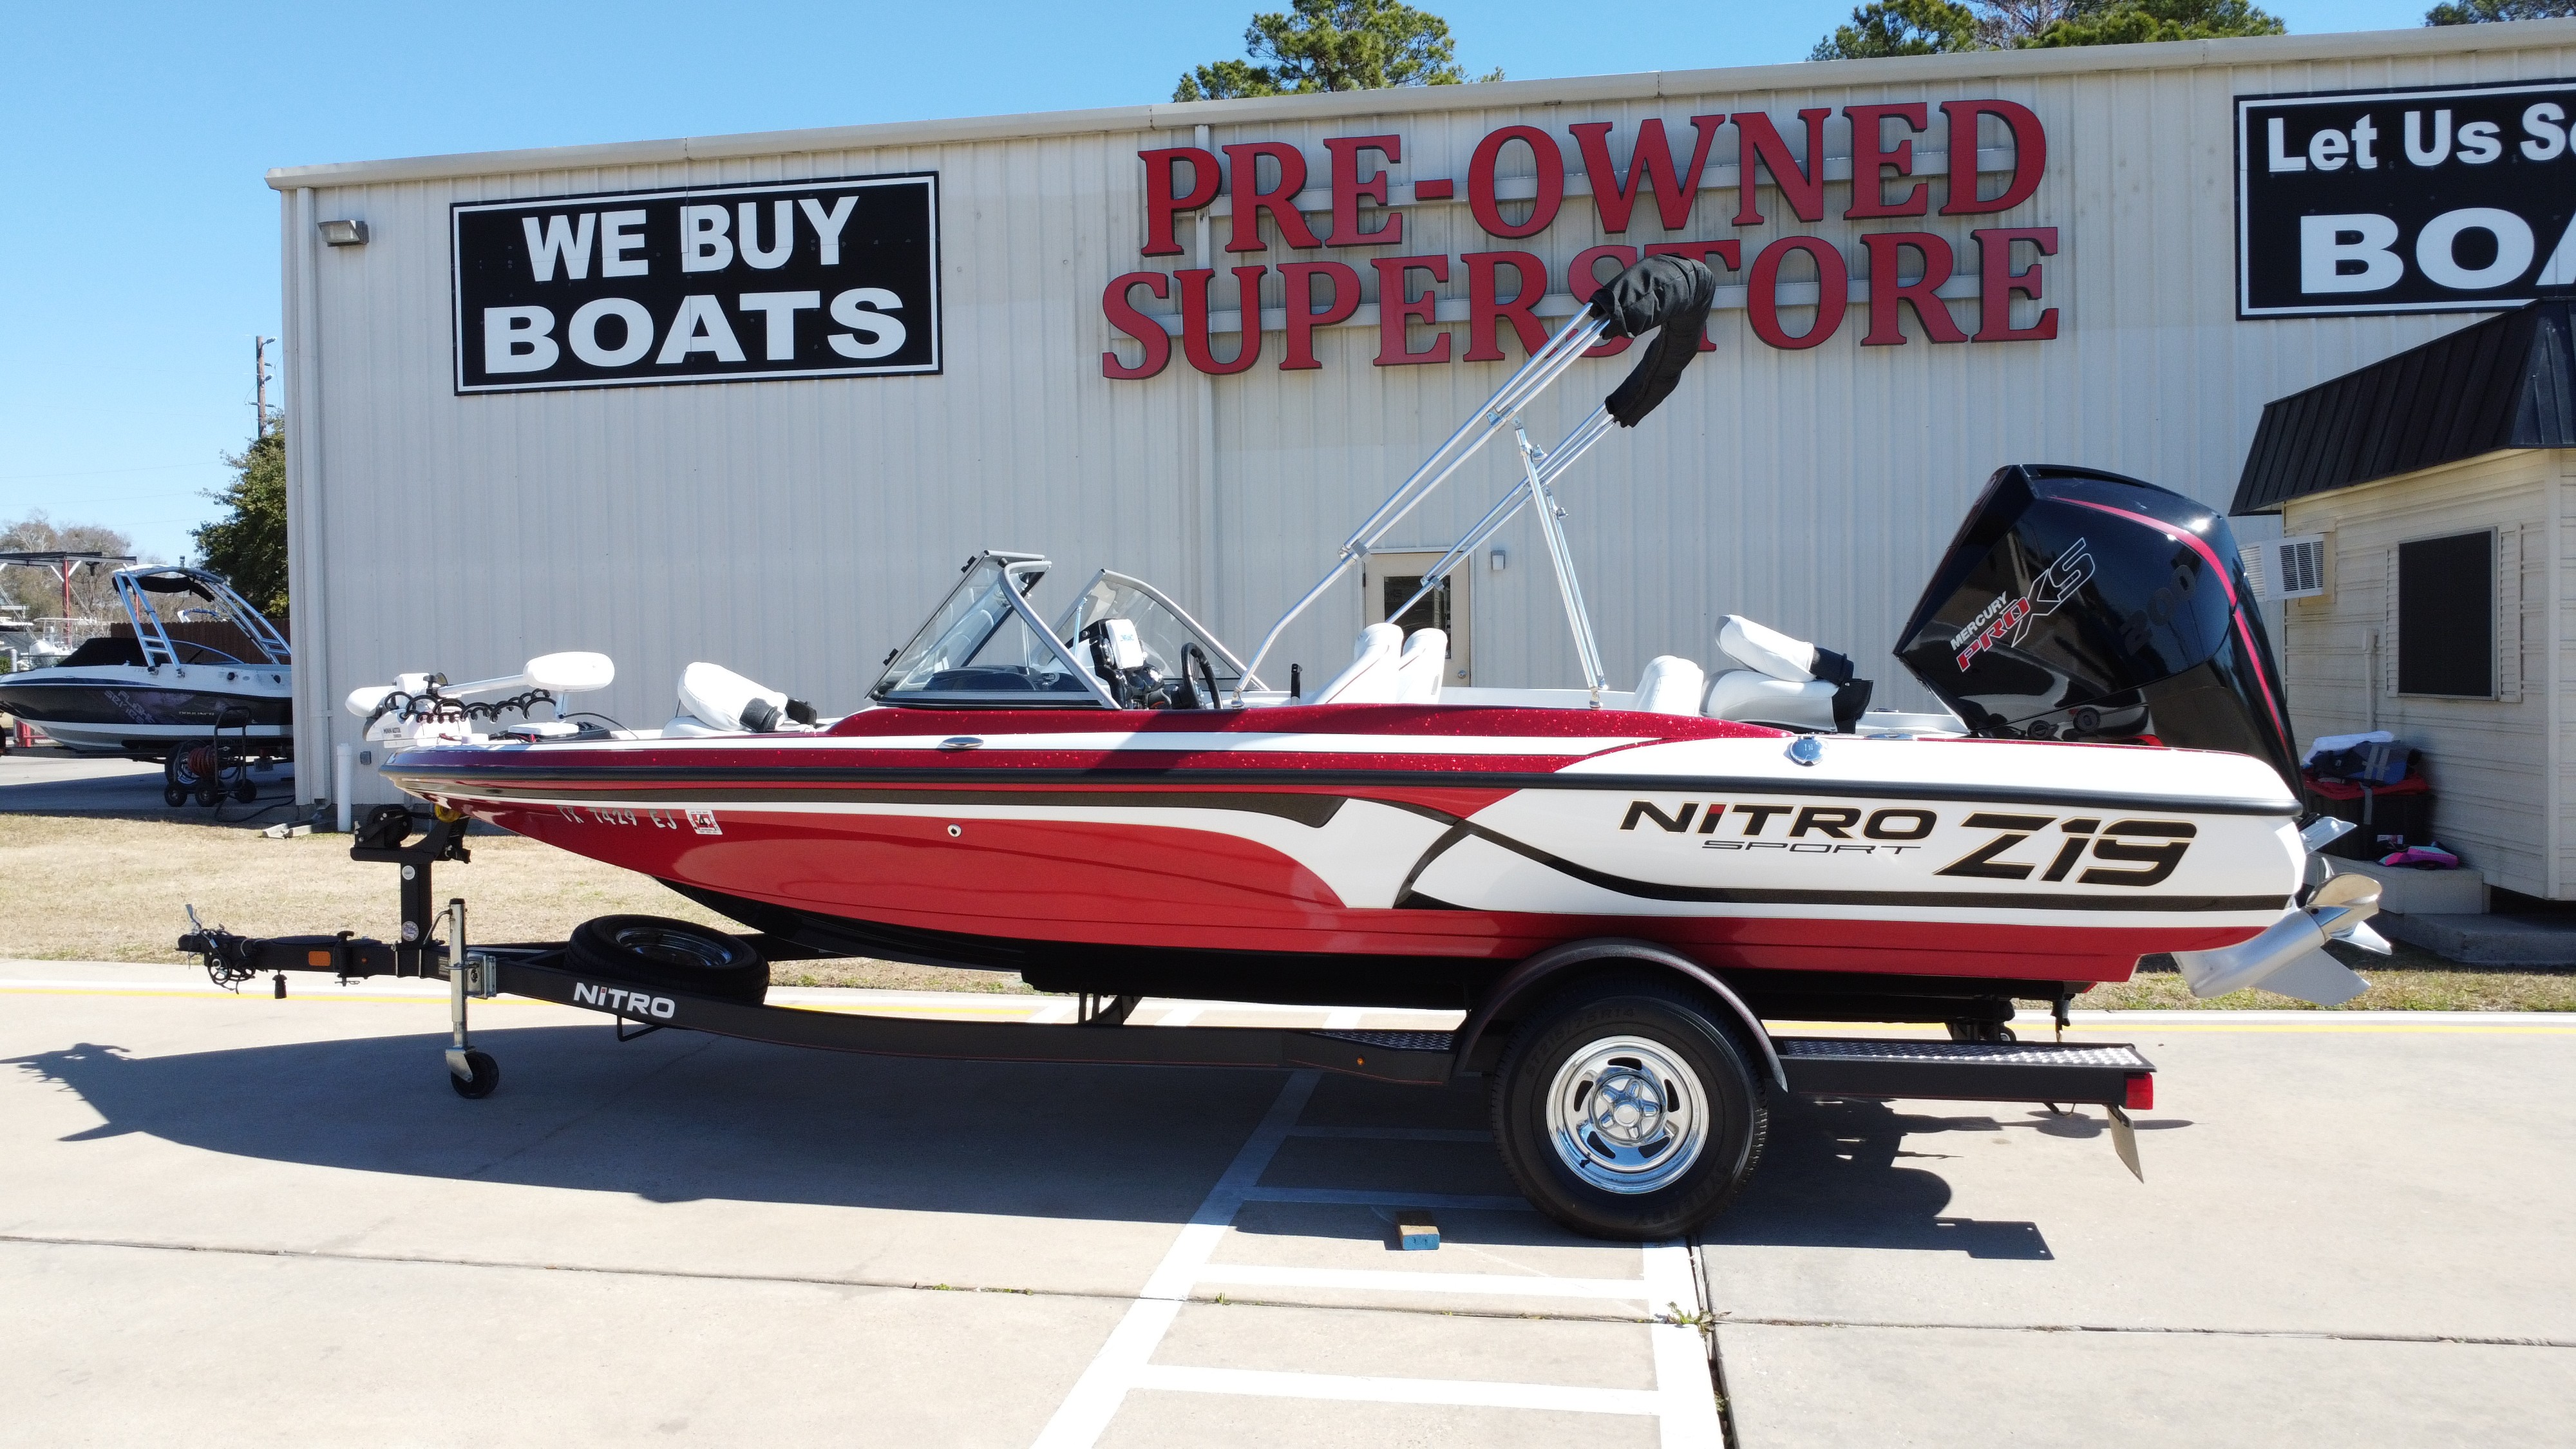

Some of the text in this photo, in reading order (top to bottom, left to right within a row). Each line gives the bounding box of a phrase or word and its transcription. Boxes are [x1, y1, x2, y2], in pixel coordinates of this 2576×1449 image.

[2268, 102, 2576, 173] Let Us S
[1137, 98, 2047, 257] PRE-OWNED
[522, 195, 860, 282] WE BUY
[484, 287, 907, 374] BOATS
[1950, 591, 2007, 650] MERCURY
[1618, 799, 2198, 886] NITRO Z19
[1701, 840, 1922, 856] SPORT
[573, 982, 676, 1018] NITRO
